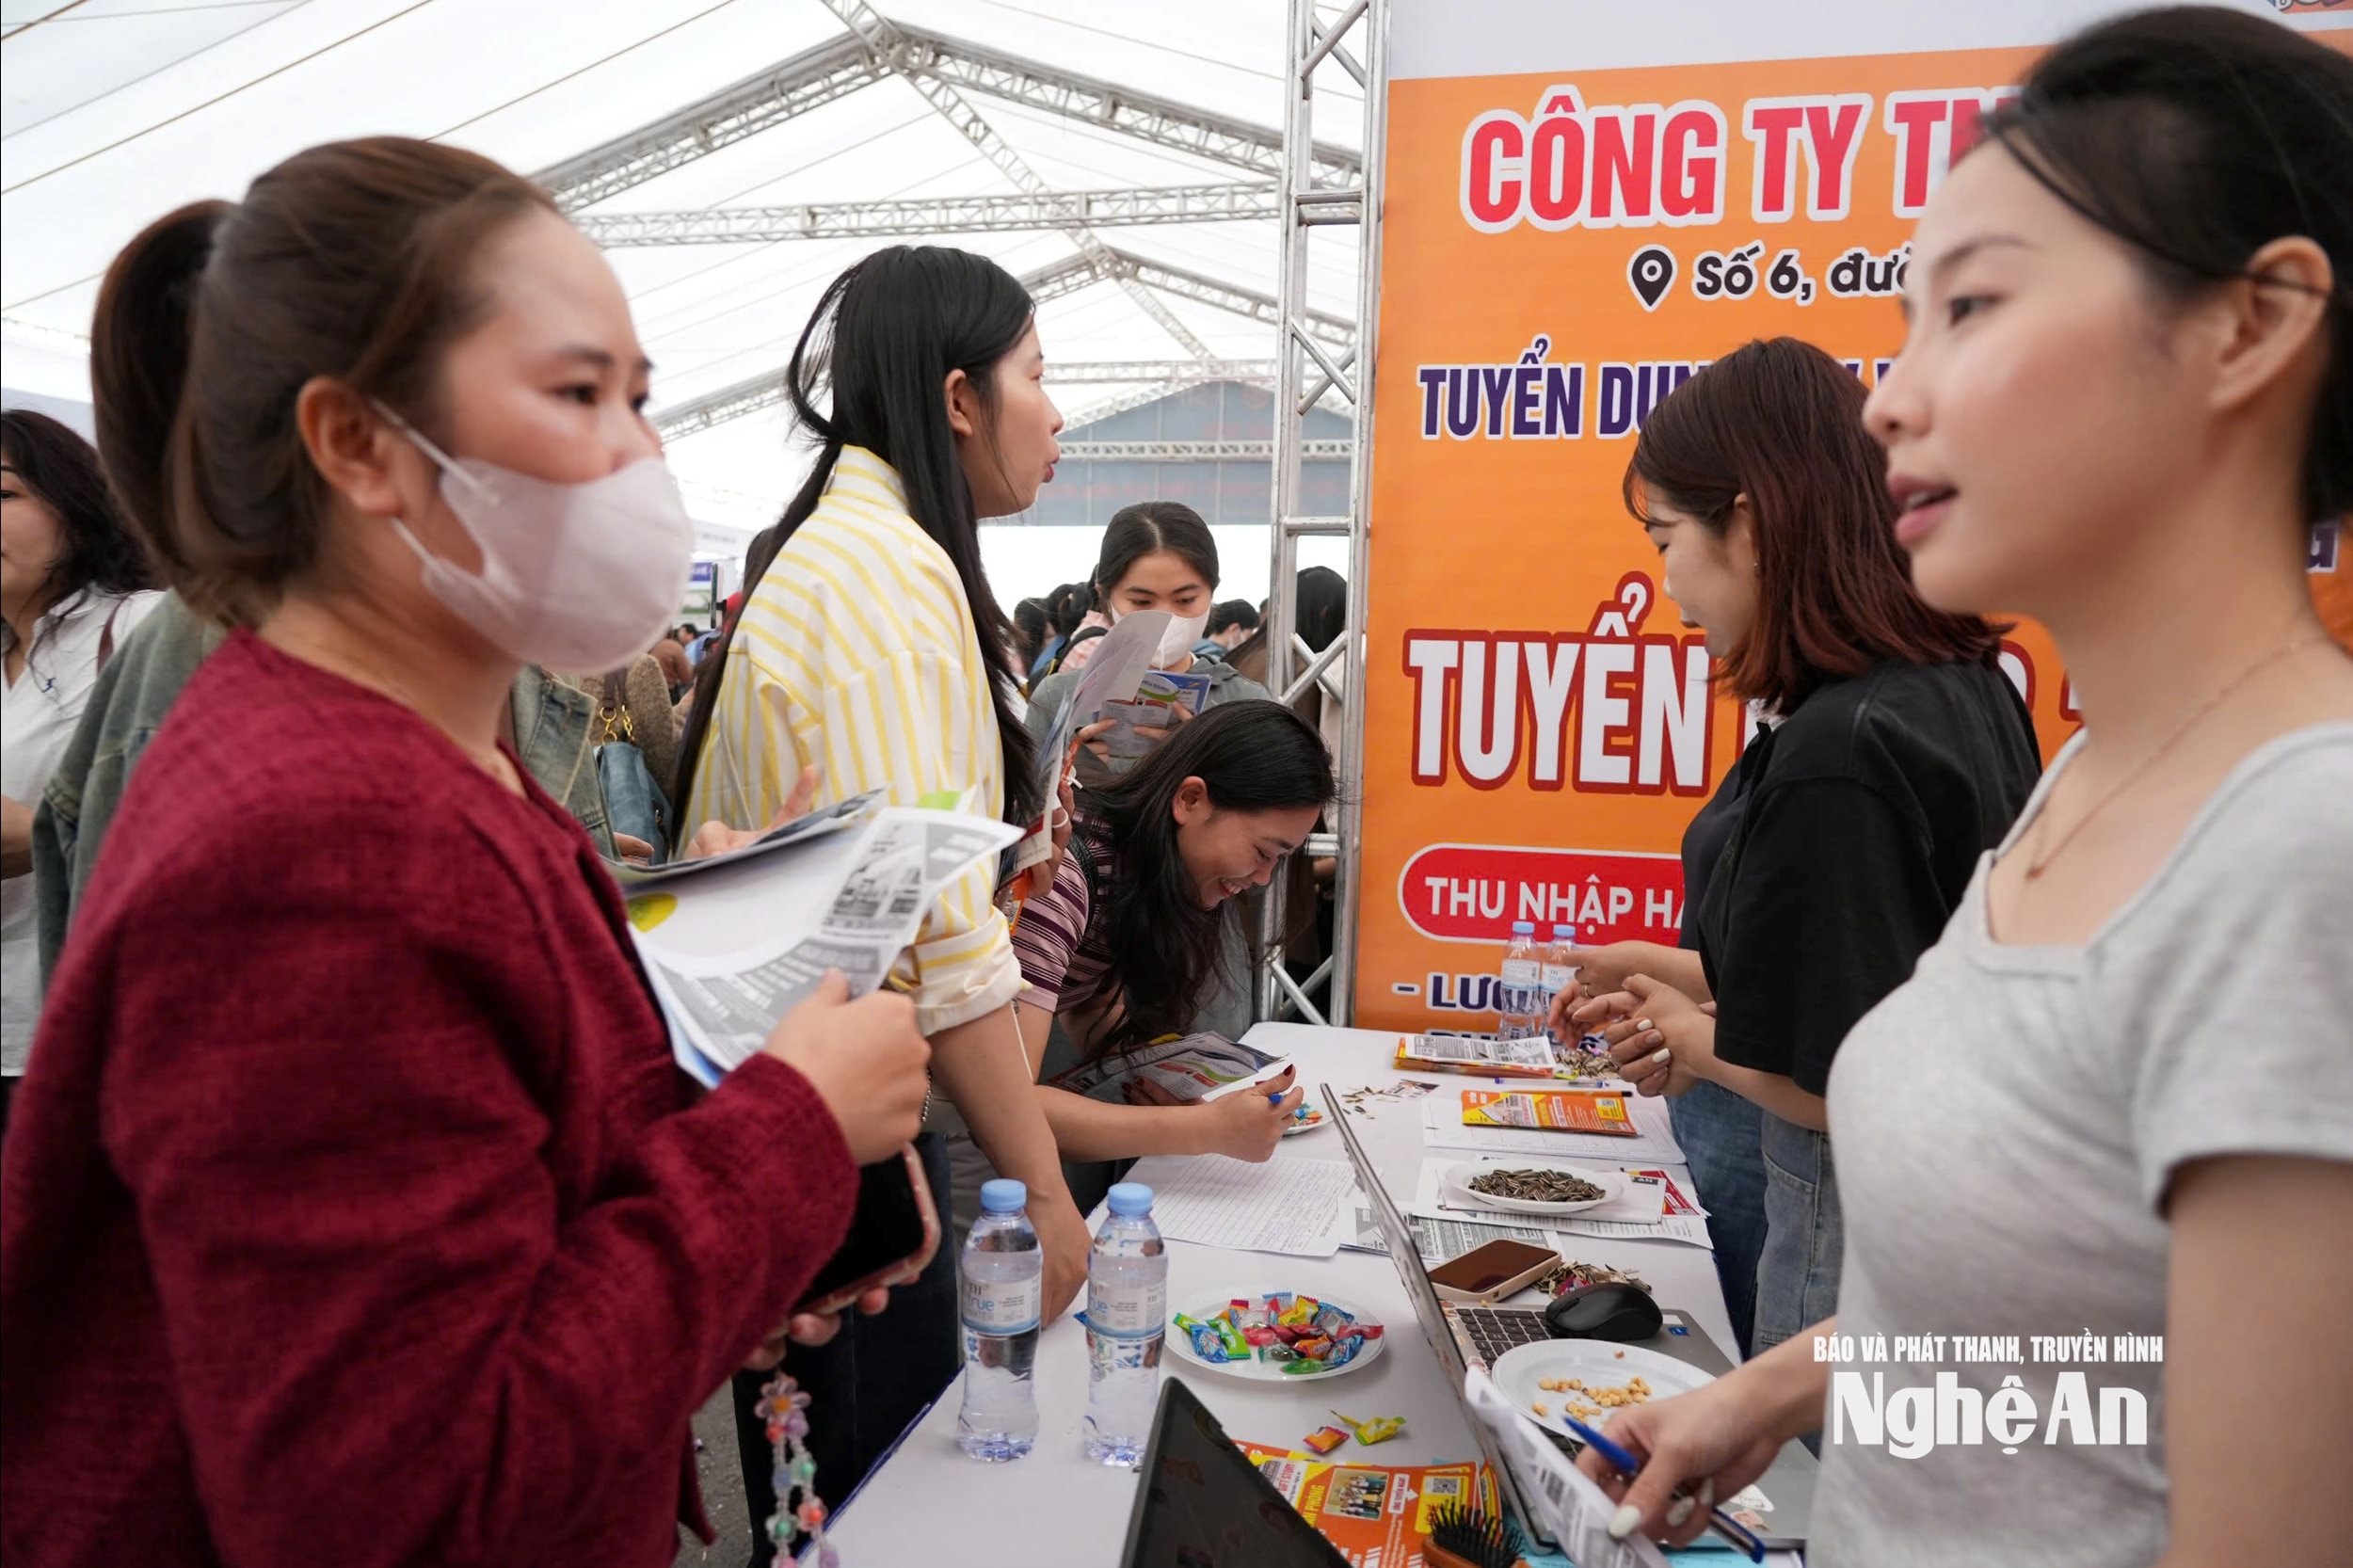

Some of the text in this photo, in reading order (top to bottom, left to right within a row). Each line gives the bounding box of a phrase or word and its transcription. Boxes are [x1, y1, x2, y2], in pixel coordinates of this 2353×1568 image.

[1466, 94, 2024, 225] CÔNG TY T
[1696, 243, 1760, 296] Số
[1769, 253, 1814, 302] 6,
[1418, 337, 1583, 436] TUYỂN
[1408, 581, 1710, 789] TUYỂN
[1424, 875, 1506, 920] THU
[1518, 873, 1634, 936] NHẬP
